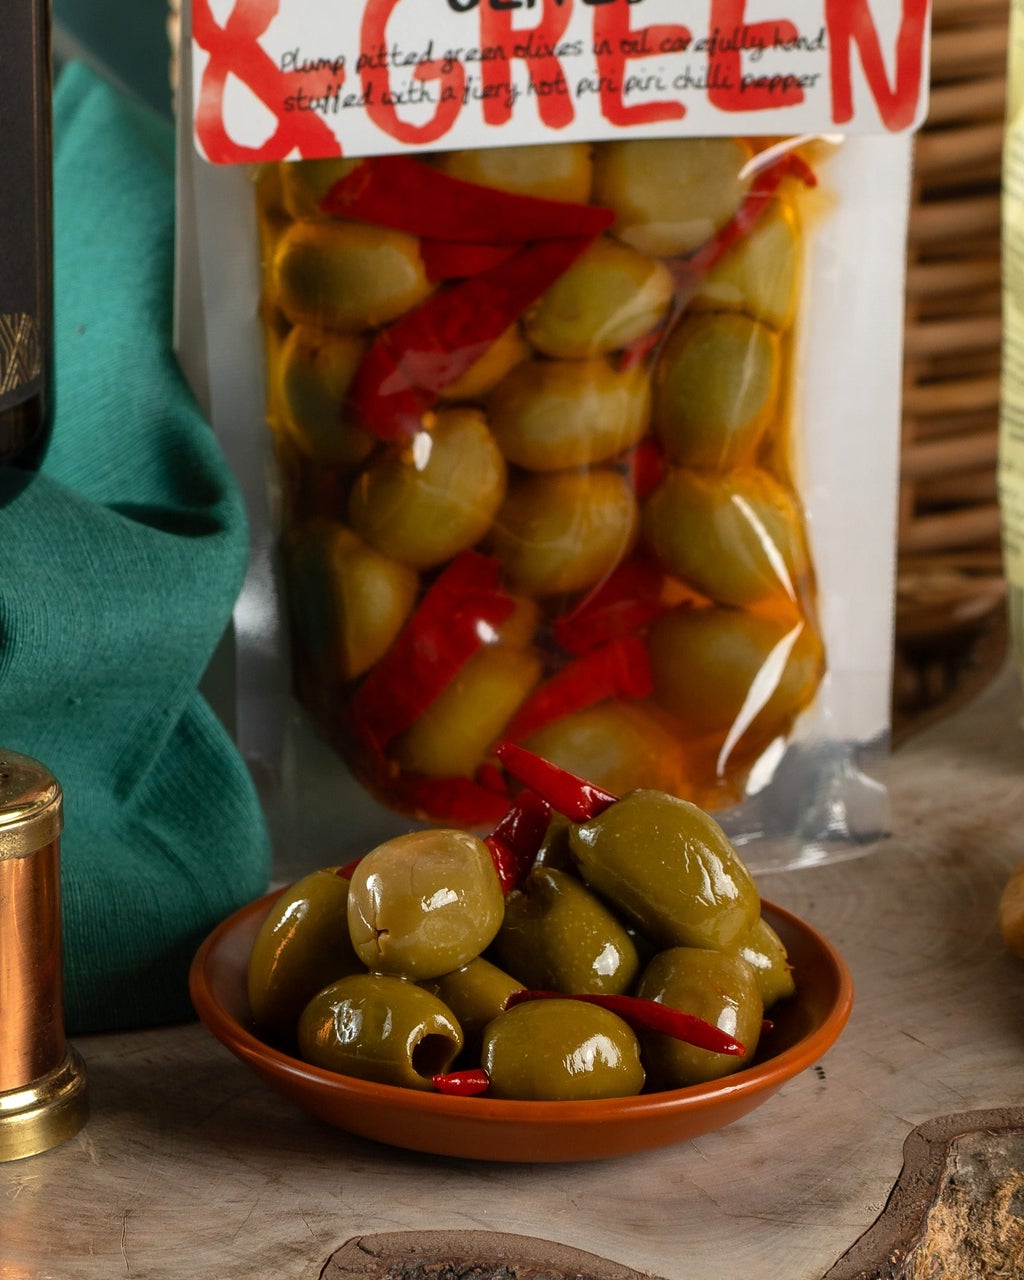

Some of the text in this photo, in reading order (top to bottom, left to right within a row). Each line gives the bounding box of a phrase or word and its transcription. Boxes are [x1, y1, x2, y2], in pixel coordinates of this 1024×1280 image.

[280, 26, 826, 78] Plump pitted green olives in oil carefully hand
[283, 63, 822, 115] stuffed with a fiery hot piri piri chilli pepper
